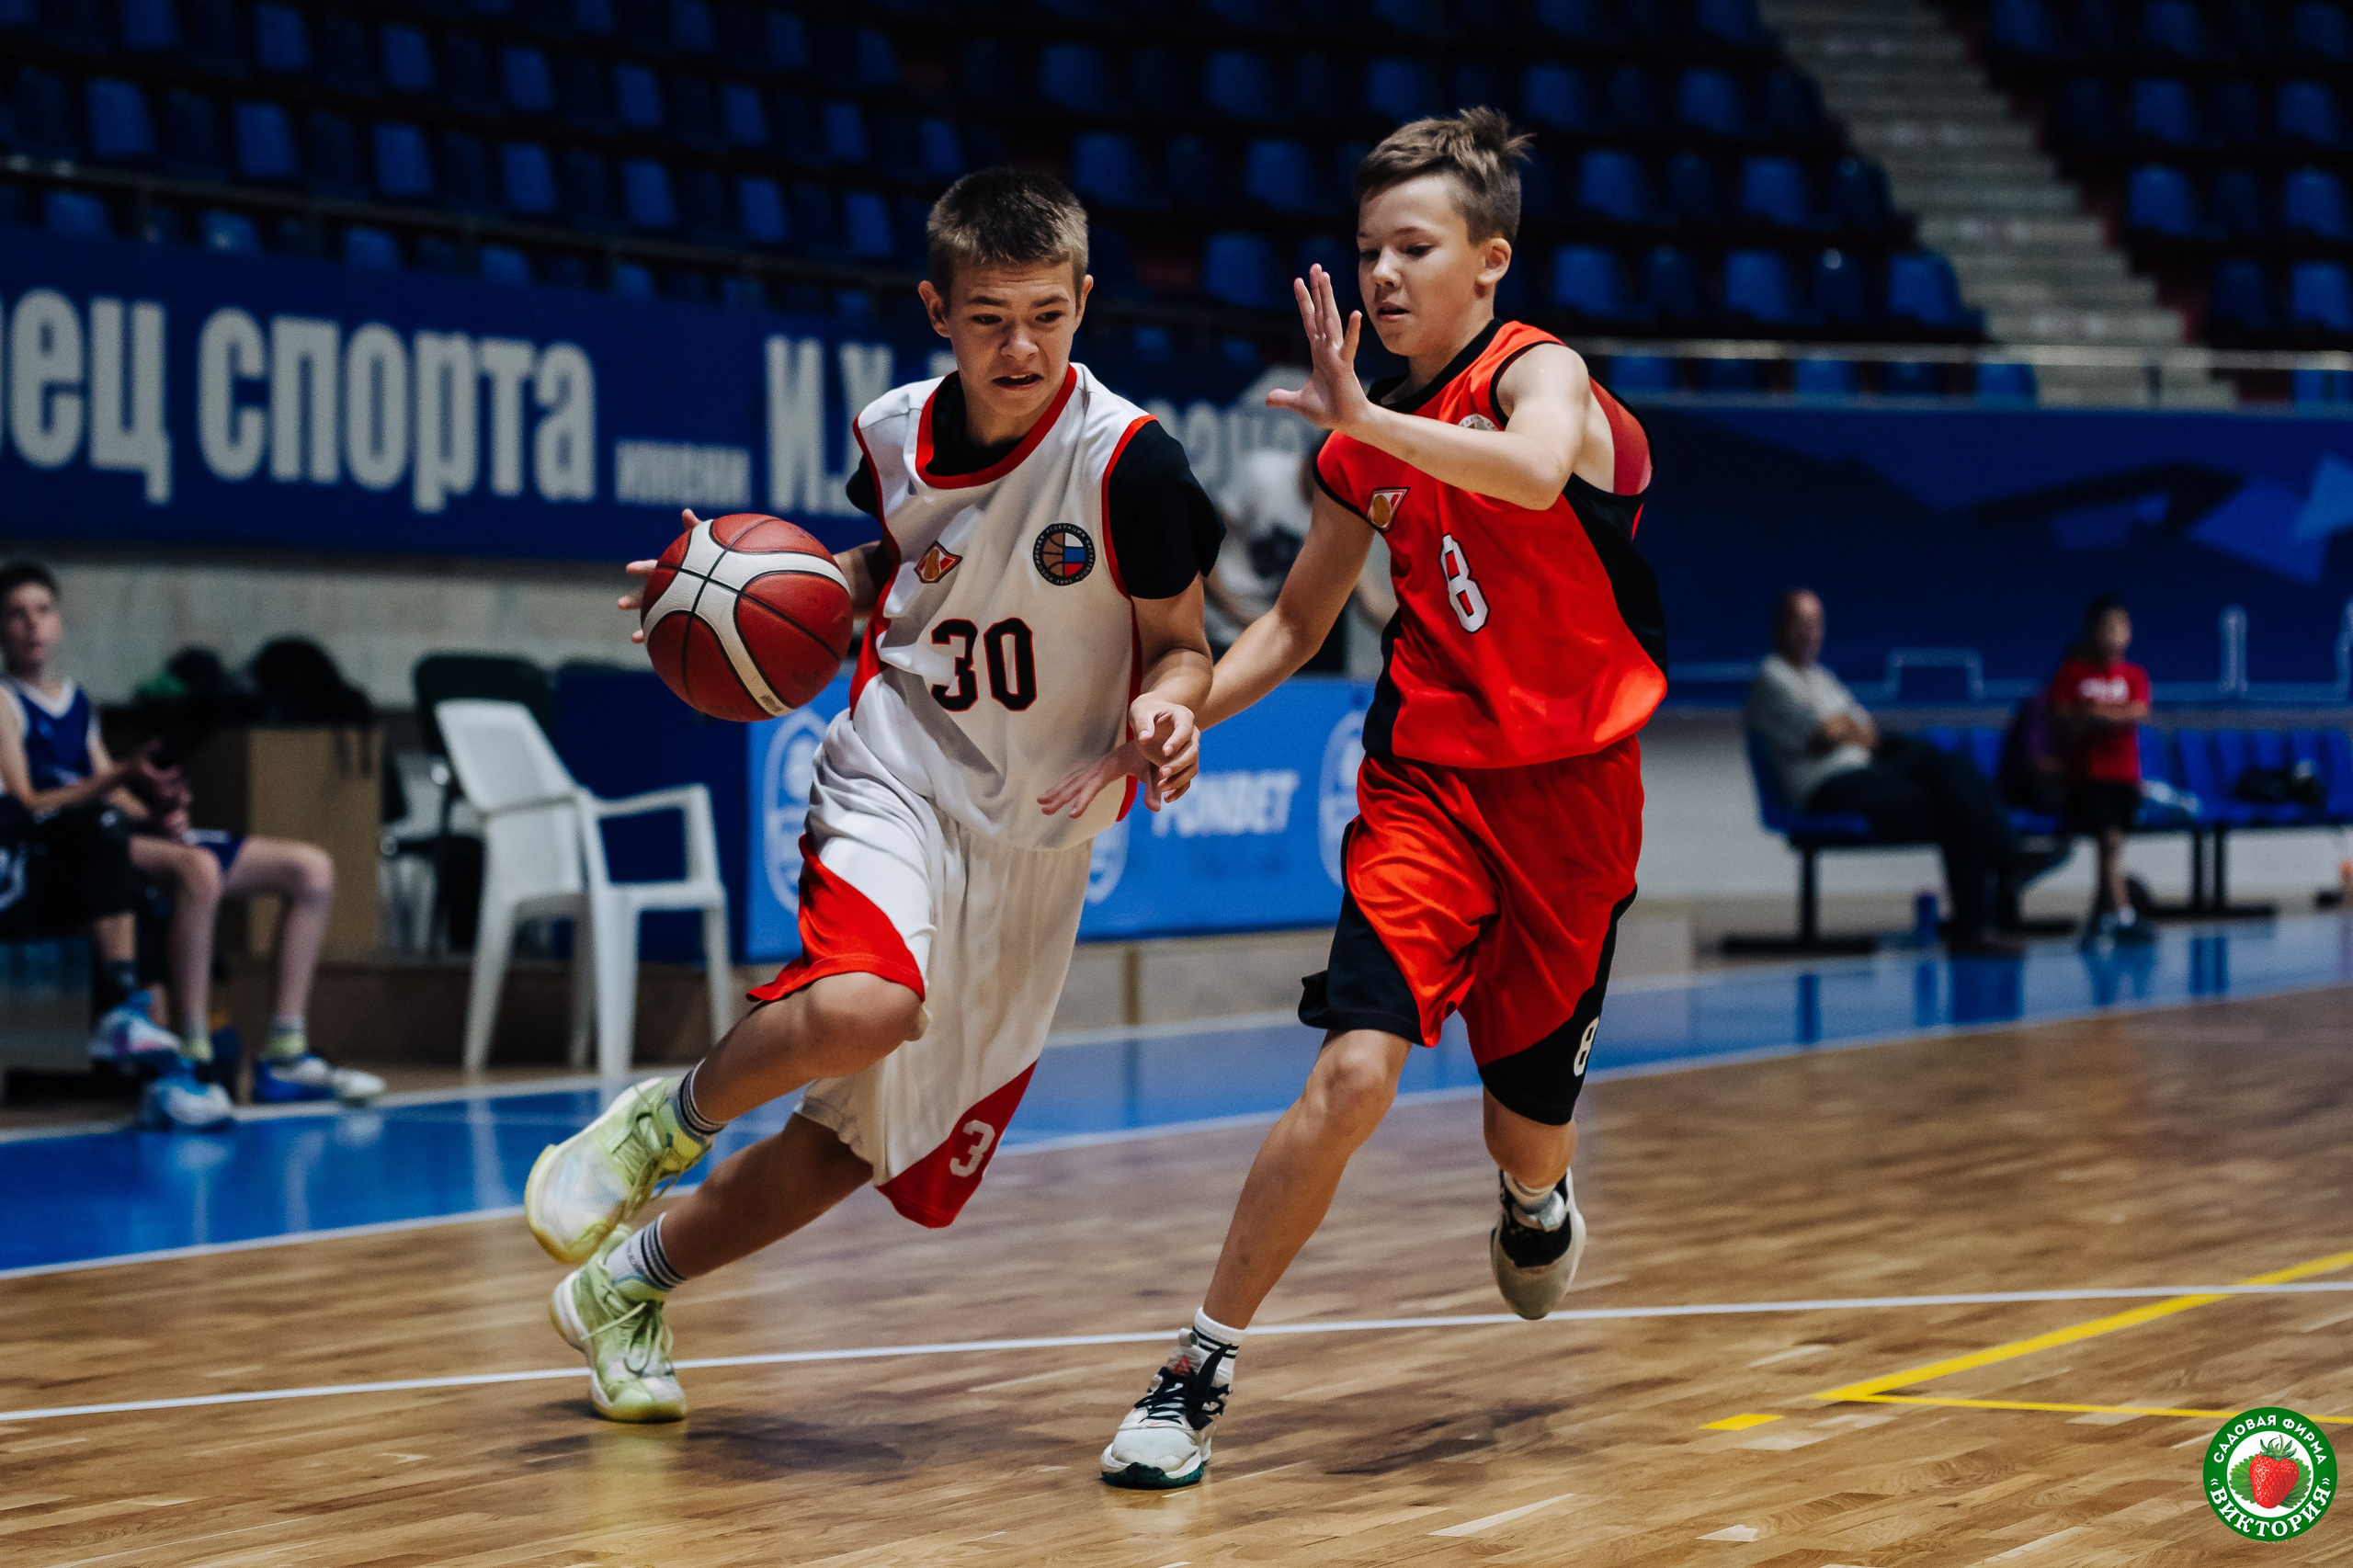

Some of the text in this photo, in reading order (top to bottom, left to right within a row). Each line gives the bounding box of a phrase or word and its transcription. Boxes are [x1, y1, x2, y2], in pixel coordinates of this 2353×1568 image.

[0, 288, 173, 506] ец
[196, 305, 597, 514] спорта
[1439, 532, 1491, 634] 8
[930, 617, 1038, 712] 30
[1573, 1016, 1599, 1077] 8
[949, 1119, 995, 1177] 3
